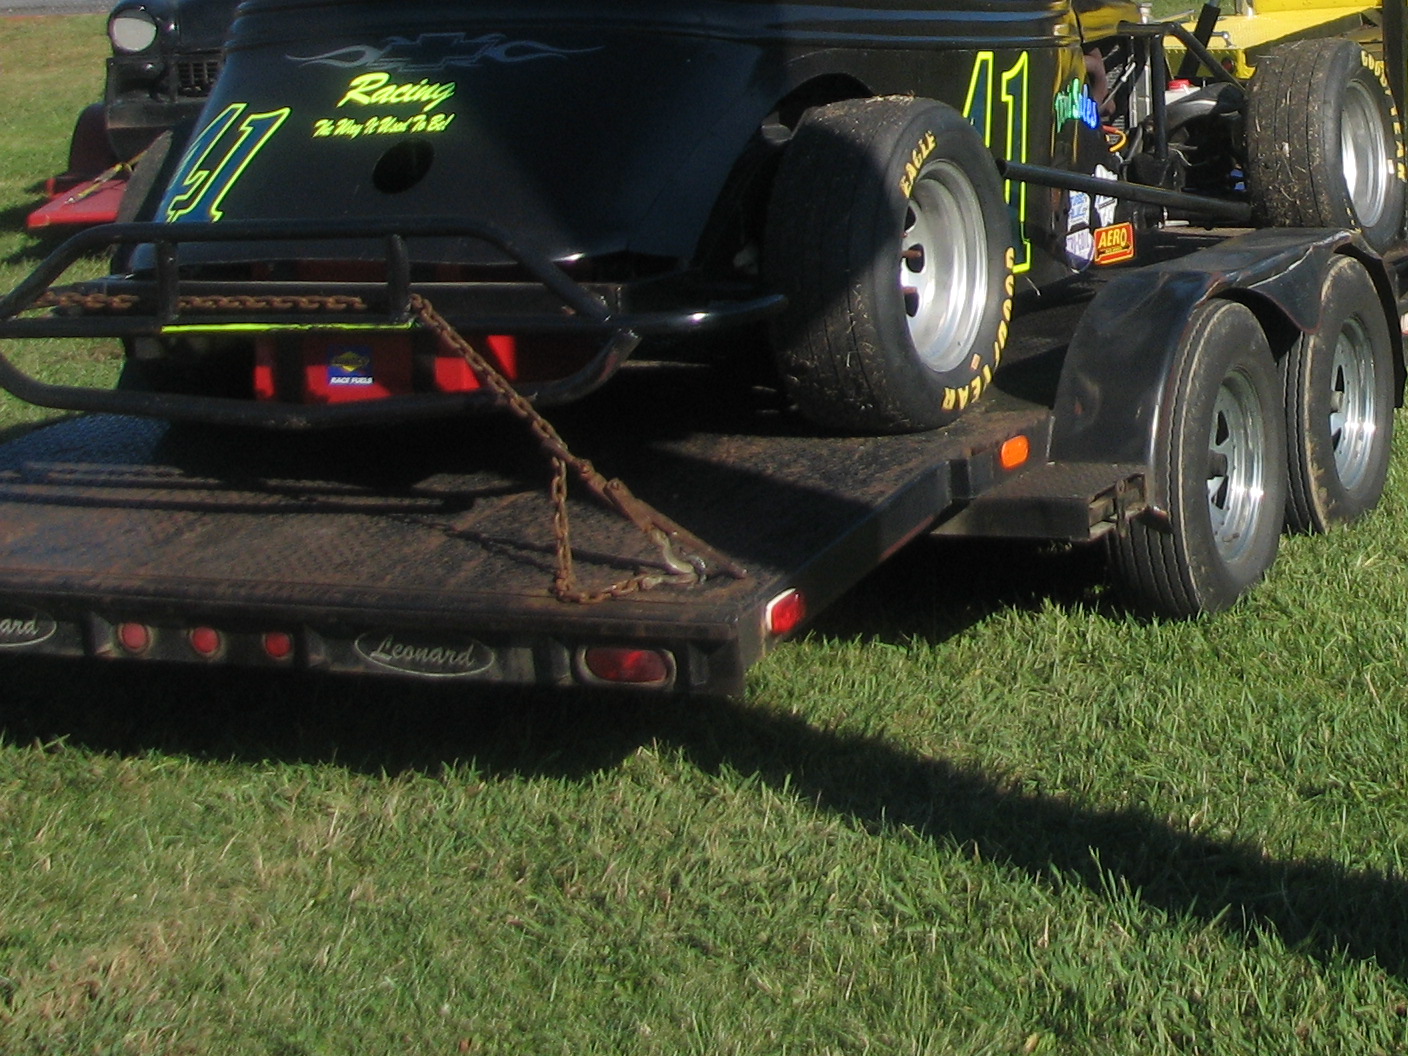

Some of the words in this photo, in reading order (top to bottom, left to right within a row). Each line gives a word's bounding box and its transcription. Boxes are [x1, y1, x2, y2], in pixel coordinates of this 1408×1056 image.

[336, 72, 456, 112] Racing
[164, 102, 290, 223] 41
[899, 129, 937, 199] EAGLE
[1097, 227, 1128, 249] AERO
[369, 634, 476, 668] Leonard
